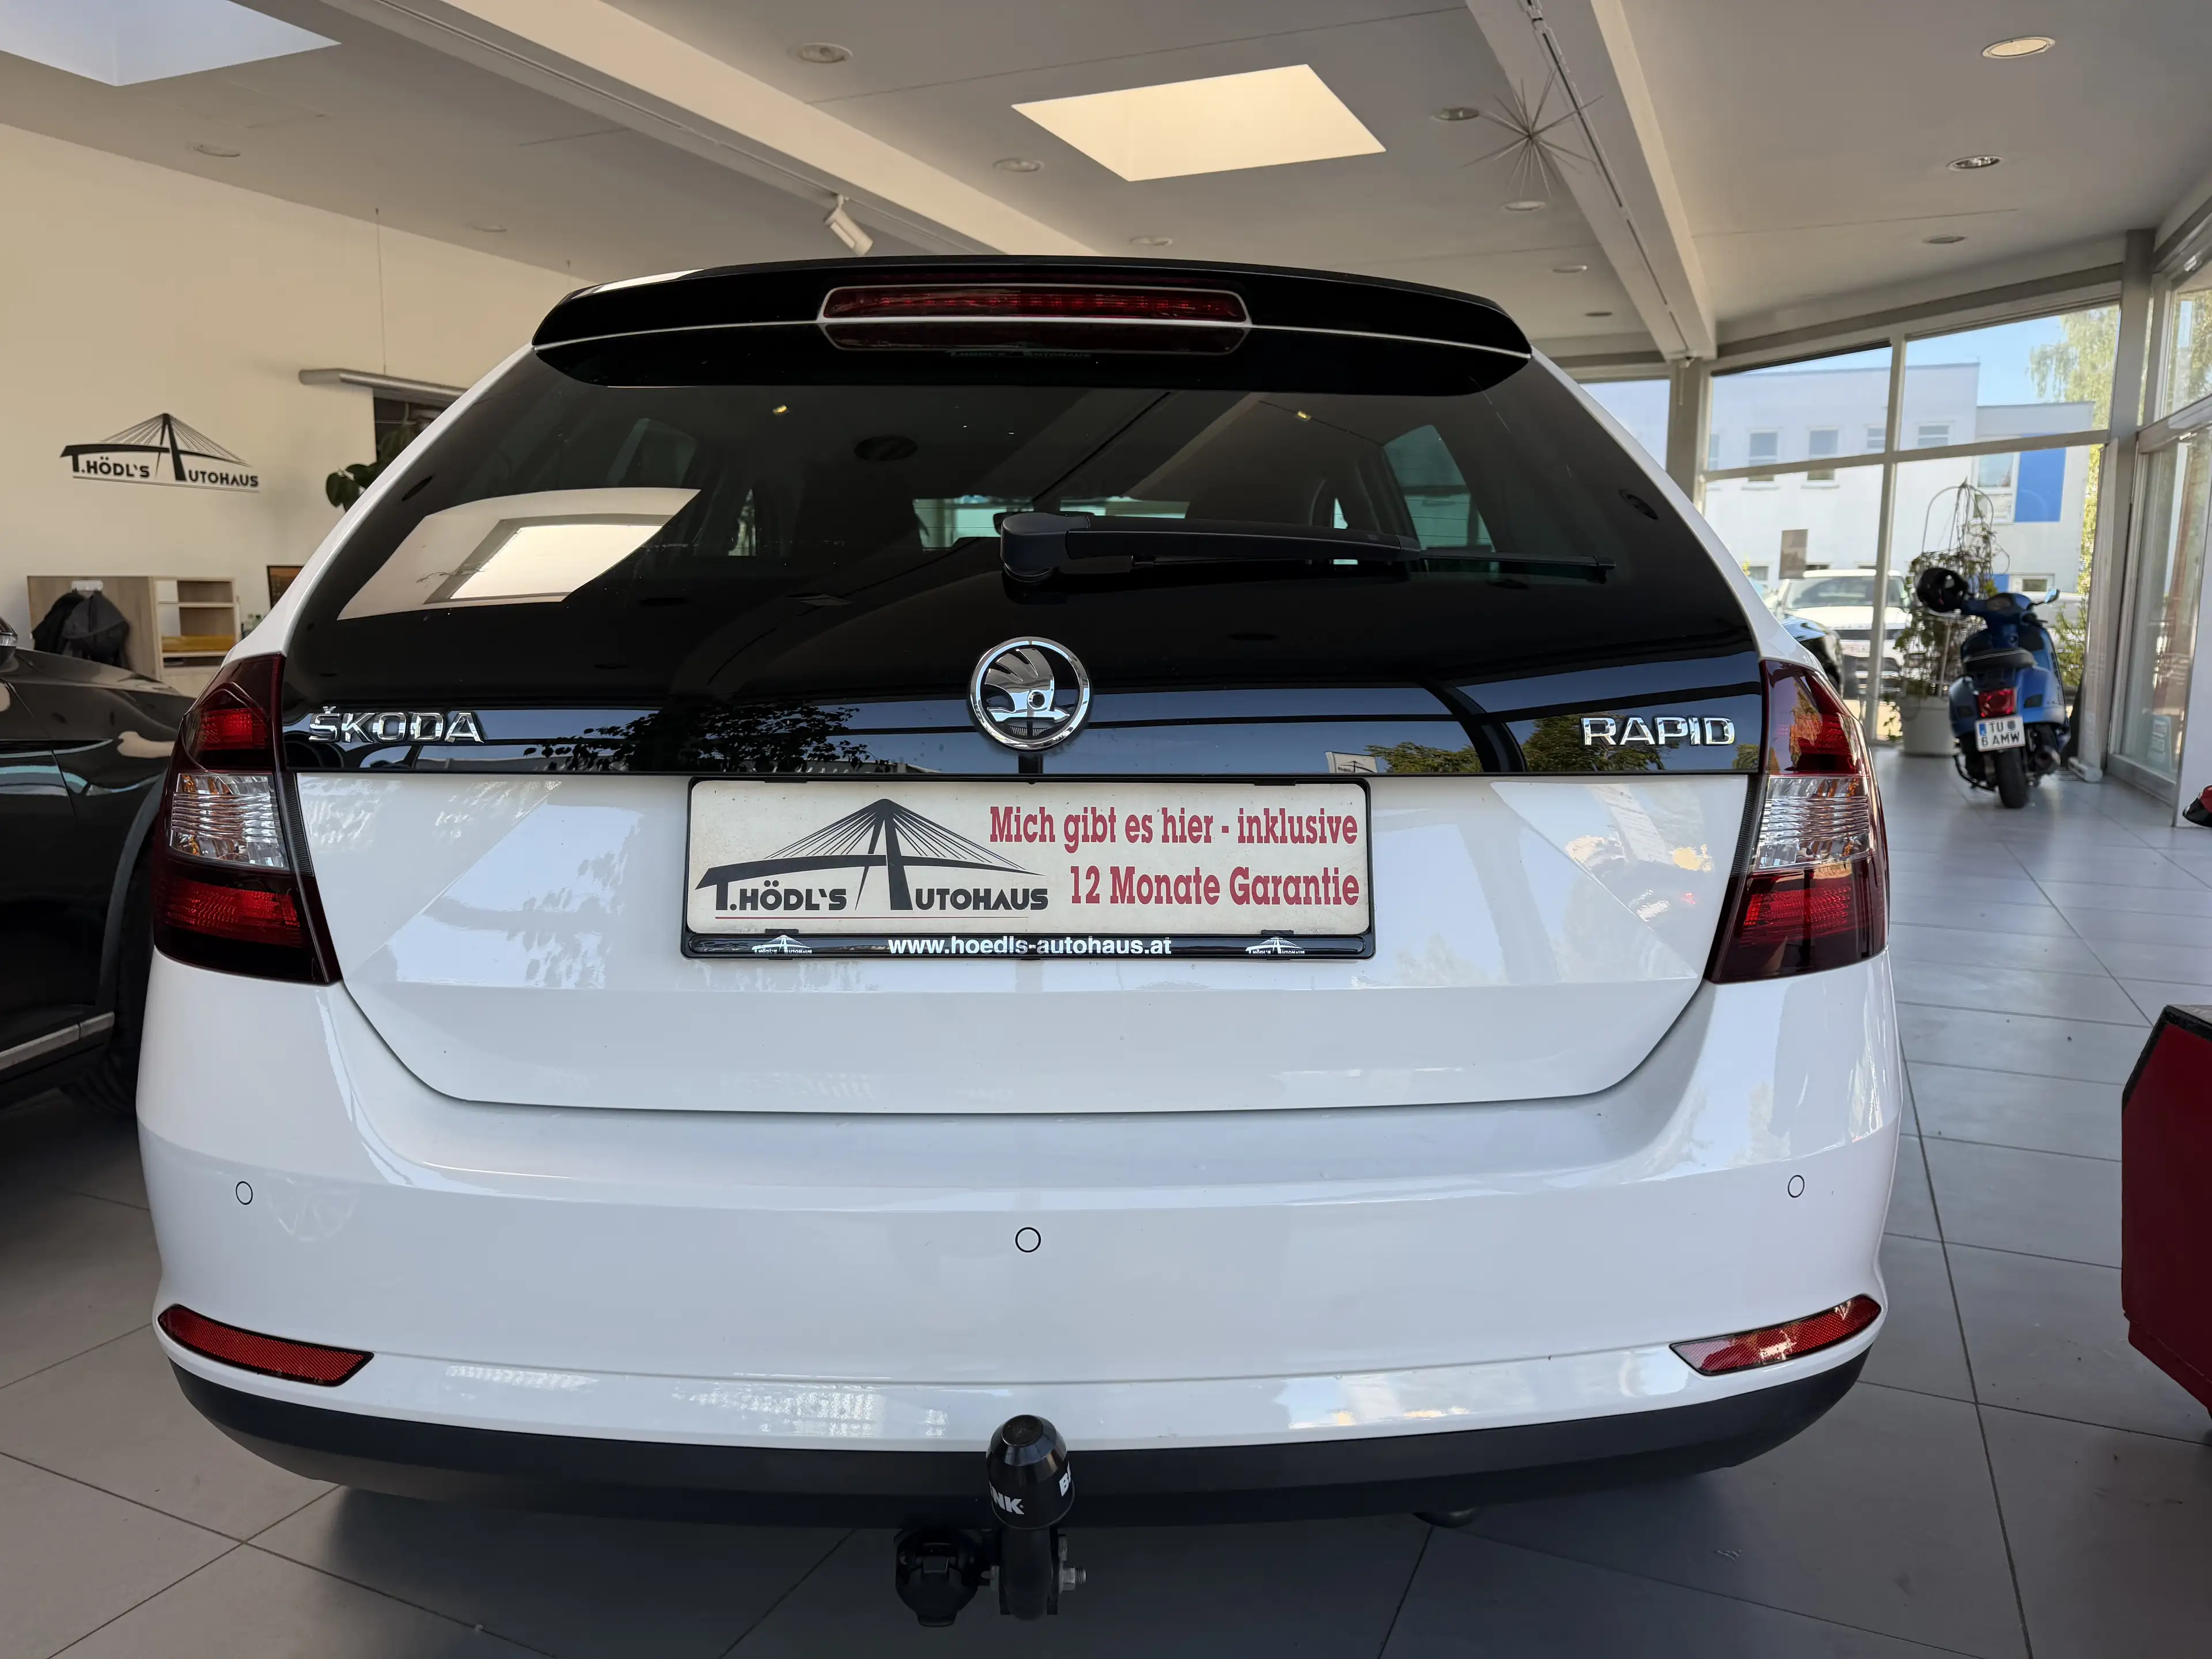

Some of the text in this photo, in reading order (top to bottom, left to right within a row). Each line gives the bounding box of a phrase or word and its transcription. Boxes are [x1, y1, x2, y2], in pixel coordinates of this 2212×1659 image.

[309, 706, 484, 743] ŠKODA
[1581, 717, 1735, 745] RAPID
[1990, 721, 2003, 733] TU
[1993, 730, 2020, 745] AMW
[990, 806, 1055, 843] Mich
[1064, 807, 1116, 853] gibt
[1126, 815, 1153, 843] es
[1162, 808, 1213, 843] hier
[1238, 808, 1358, 844] inklusive
[1070, 866, 1359, 905] 12 Monate Garantie
[888, 935, 1173, 955] www.hoedls-autohaus.at
